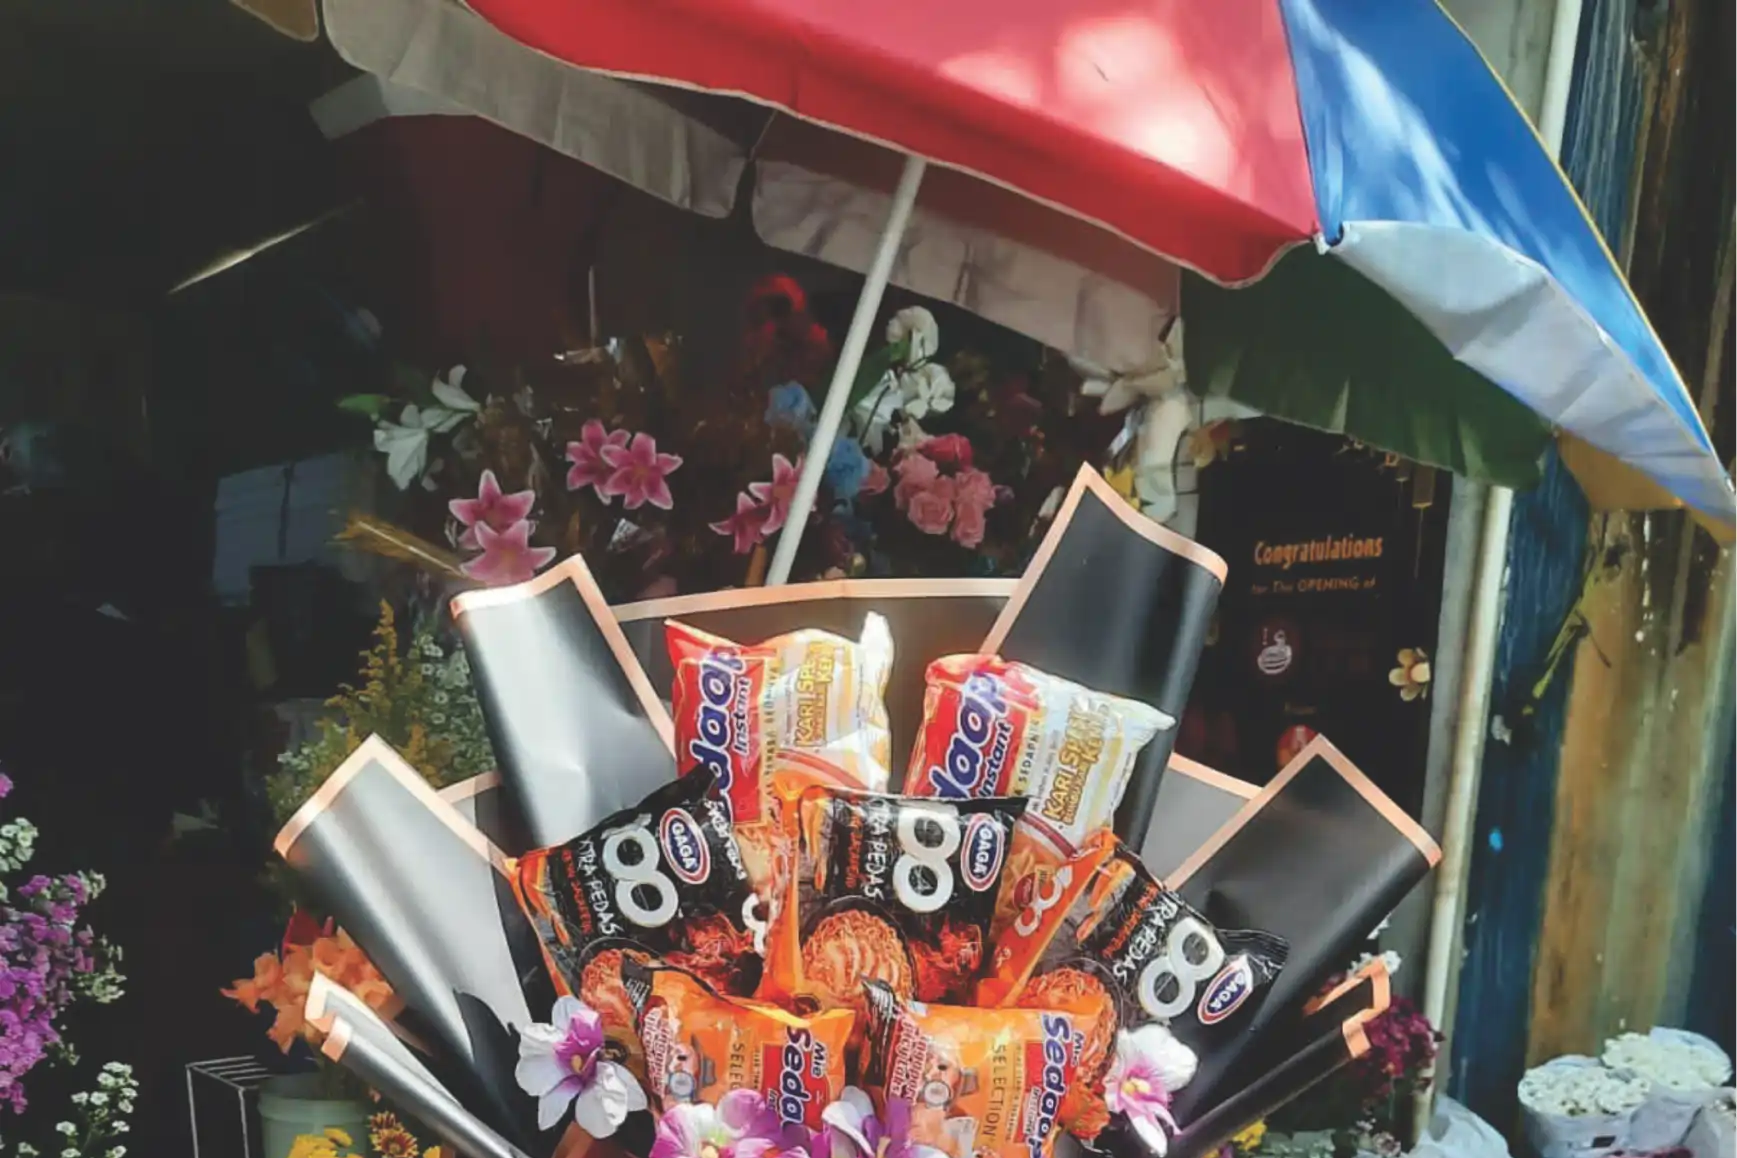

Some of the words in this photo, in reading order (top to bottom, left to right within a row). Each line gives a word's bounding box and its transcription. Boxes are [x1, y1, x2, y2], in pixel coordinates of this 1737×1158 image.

[1254, 534, 1383, 569] Congratulations
[1297, 576, 1360, 592] OPENING
[690, 645, 745, 798] daap
[731, 676, 751, 757] Instant
[794, 694, 817, 747] KARI
[1043, 768, 1071, 819] KARI
[672, 821, 699, 871] GAGA
[862, 840, 888, 901] PEDAS
[973, 824, 994, 876] GAGA
[577, 835, 599, 879] XTRA
[588, 879, 624, 936] PEDAS
[1112, 923, 1158, 986] PEDAS
[1208, 970, 1247, 1012] GAGA
[728, 1042, 746, 1090] SELEC
[780, 1026, 812, 1129] Seda
[811, 1041, 828, 1079] Mie
[982, 1043, 1008, 1137] SELECTION
